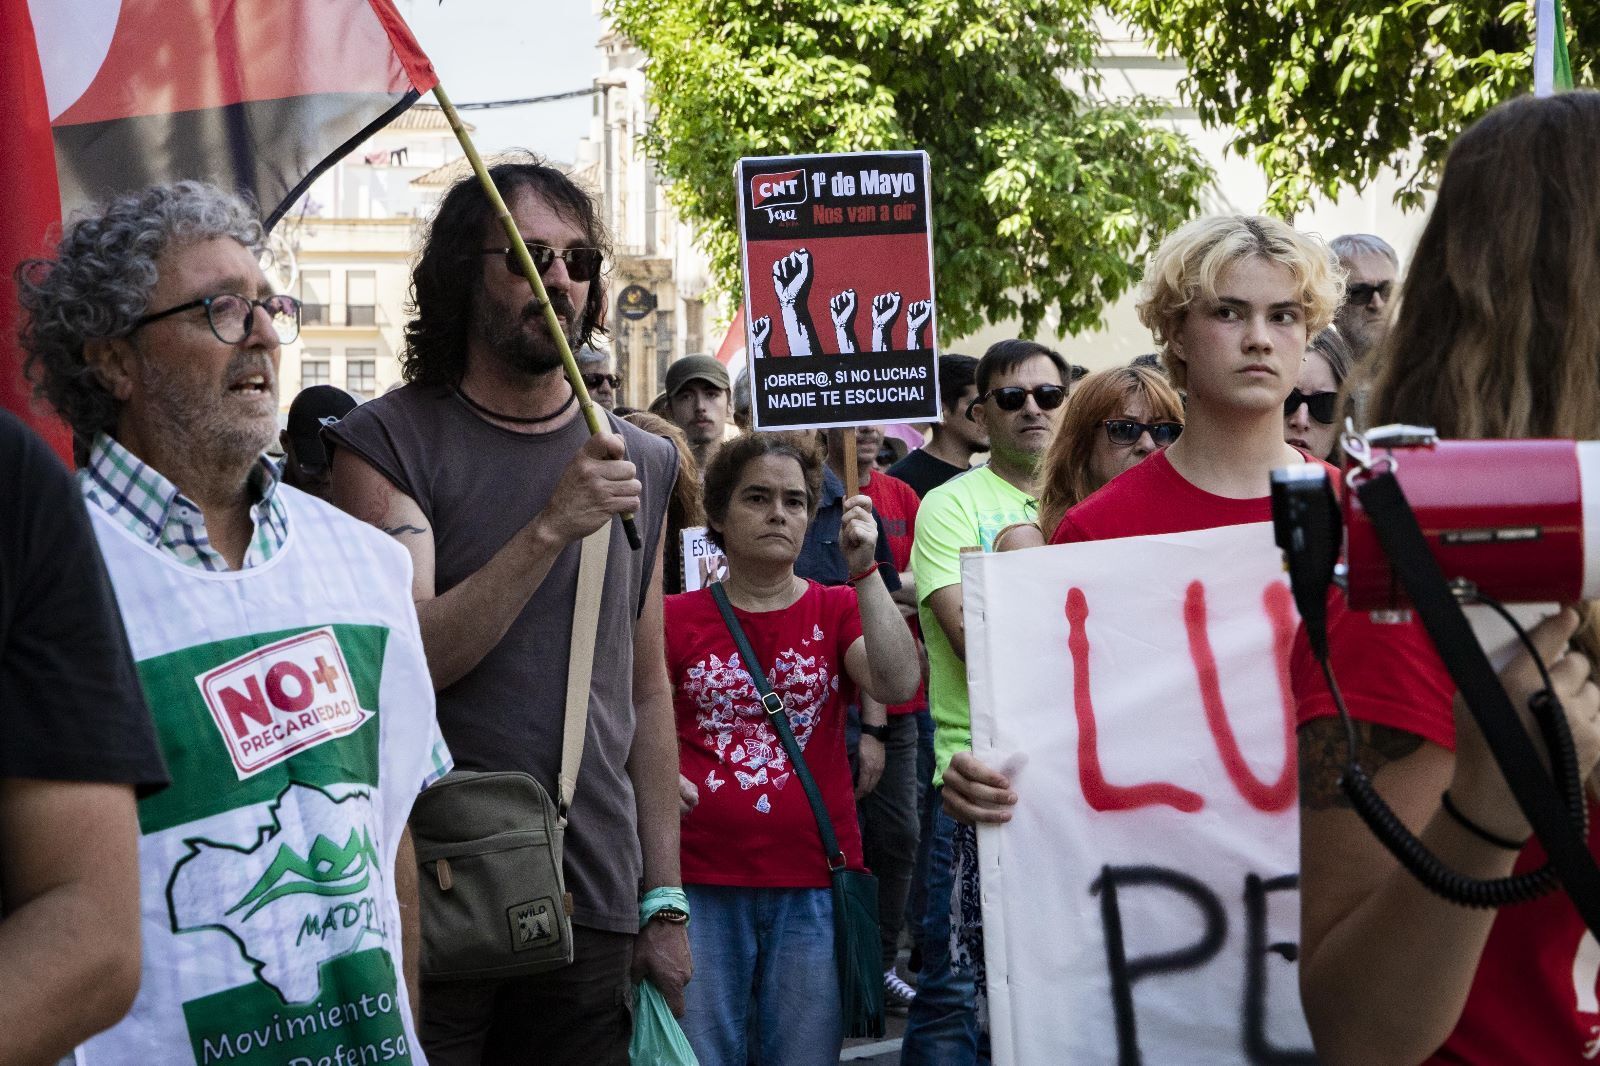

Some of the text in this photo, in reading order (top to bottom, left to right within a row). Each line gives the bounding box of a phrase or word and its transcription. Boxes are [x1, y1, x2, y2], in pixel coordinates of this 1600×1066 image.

[759, 180, 798, 198] CNT
[831, 171, 856, 197] de
[859, 169, 916, 198] Mayo
[812, 204, 844, 225] Nos
[846, 205, 876, 223] van
[880, 204, 890, 222] a
[835, 370, 848, 384] SI
[851, 369, 871, 383] NO
[873, 366, 927, 382] LUCHAS
[768, 385, 925, 409] NADIE TE ESCUCHA!
[239, 700, 351, 757] PRECARIEDAD
[203, 992, 392, 1065] Movimiento
